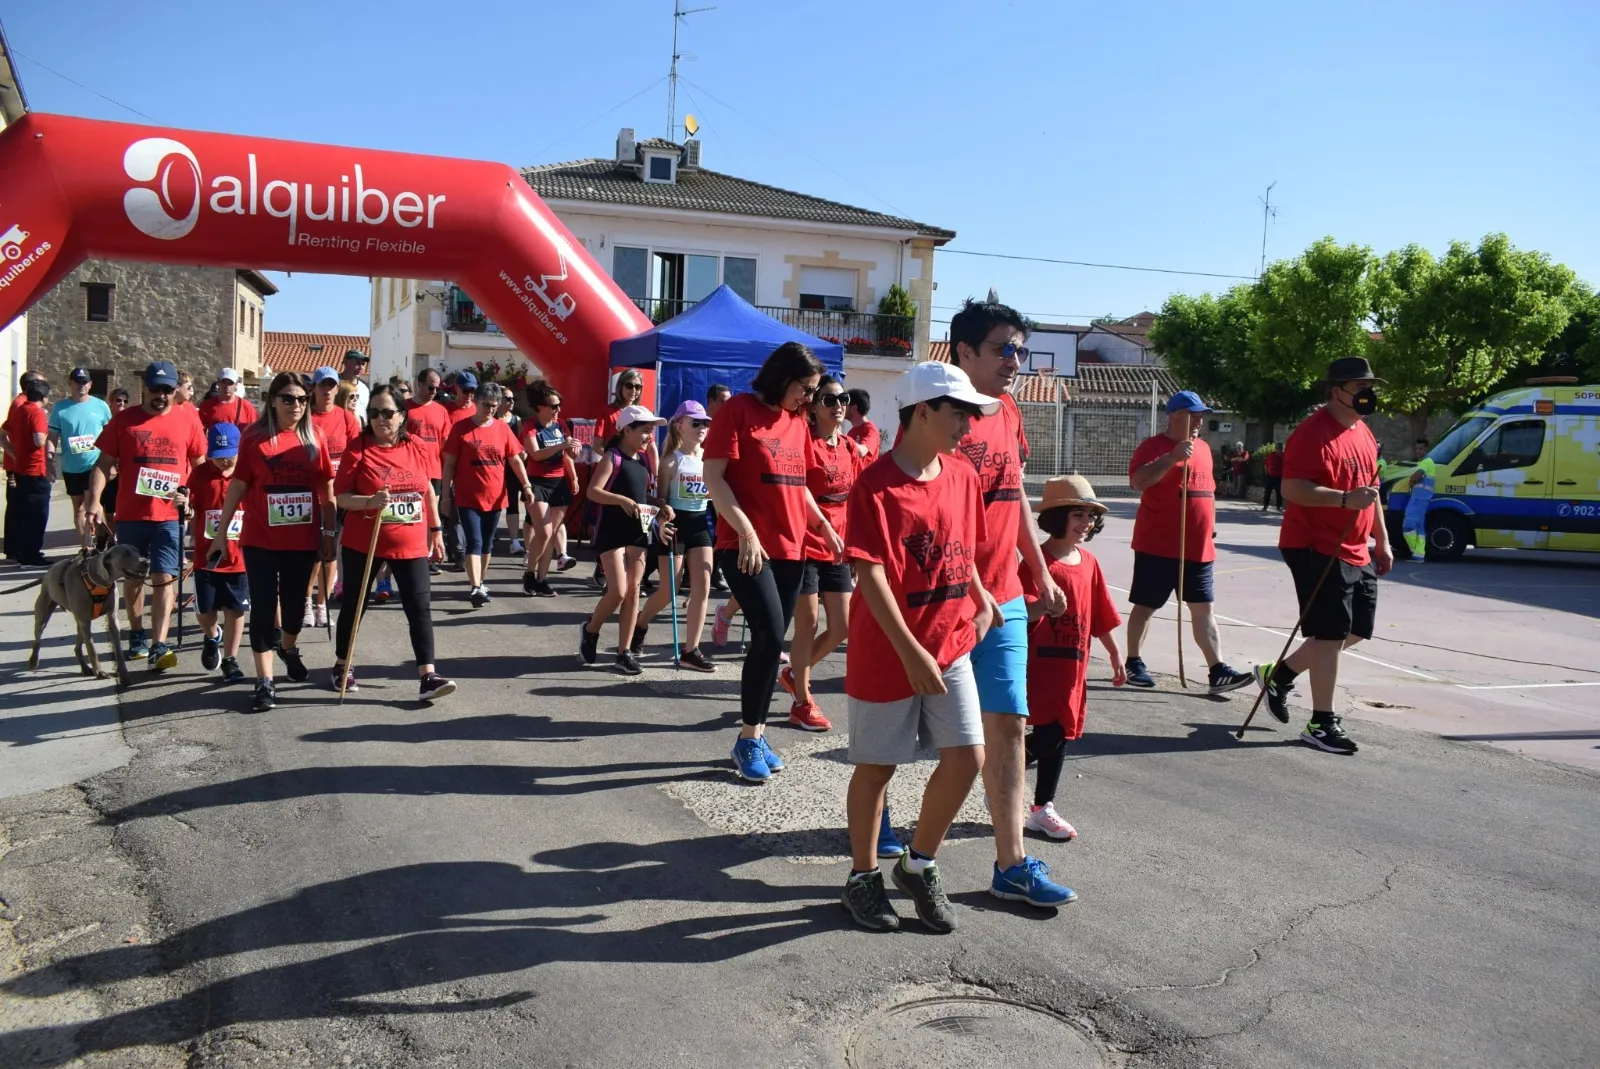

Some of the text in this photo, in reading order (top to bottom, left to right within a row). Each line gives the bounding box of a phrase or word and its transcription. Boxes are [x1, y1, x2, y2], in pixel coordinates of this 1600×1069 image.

[209, 153, 447, 246] alquiber
[298, 232, 426, 254] Renting Flexible
[498, 269, 569, 345] www.alquiber.es
[75, 441, 92, 449] 124
[774, 460, 805, 474] Tirado
[140, 468, 180, 484] bedunia
[147, 478, 170, 492] 186
[686, 481, 708, 494] 276
[269, 494, 312, 505] bedunia
[278, 504, 303, 517] 131
[390, 502, 415, 517] 100
